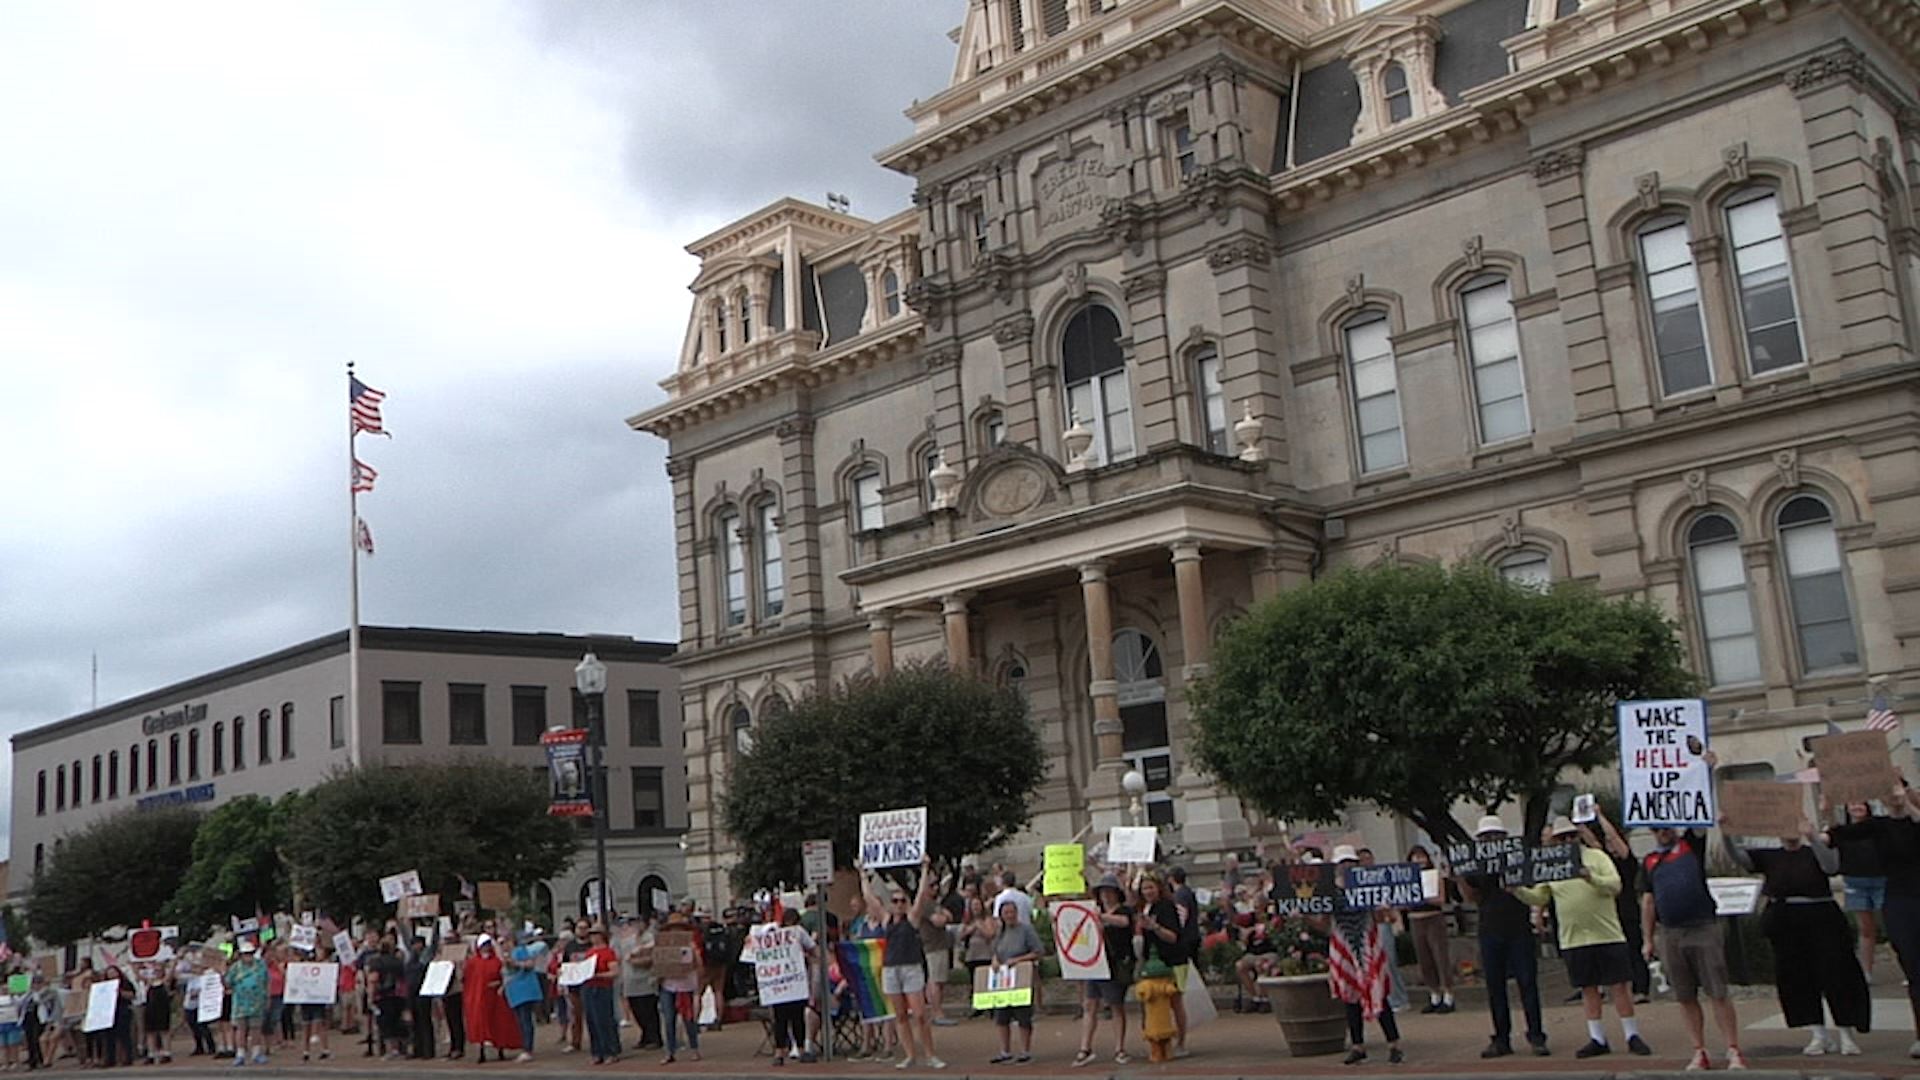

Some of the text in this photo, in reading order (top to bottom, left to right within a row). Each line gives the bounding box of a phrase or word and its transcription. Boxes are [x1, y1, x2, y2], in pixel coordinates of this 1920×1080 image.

[1635, 706, 1686, 727] WAKE
[1644, 729, 1676, 744] THE
[1635, 748, 1688, 768] HELL
[1650, 771, 1680, 788] UP
[1628, 790, 1709, 821] AMERICA
[863, 839, 921, 864] NO KINGS
[1448, 838, 1524, 862] NO KINGS
[1506, 844, 1572, 867] NO KINGS
[1389, 865, 1412, 884] You
[1532, 860, 1573, 882] Christ
[1277, 896, 1334, 915] KINGS
[1344, 883, 1422, 908] VETERANS
[756, 930, 795, 949] YOUR
